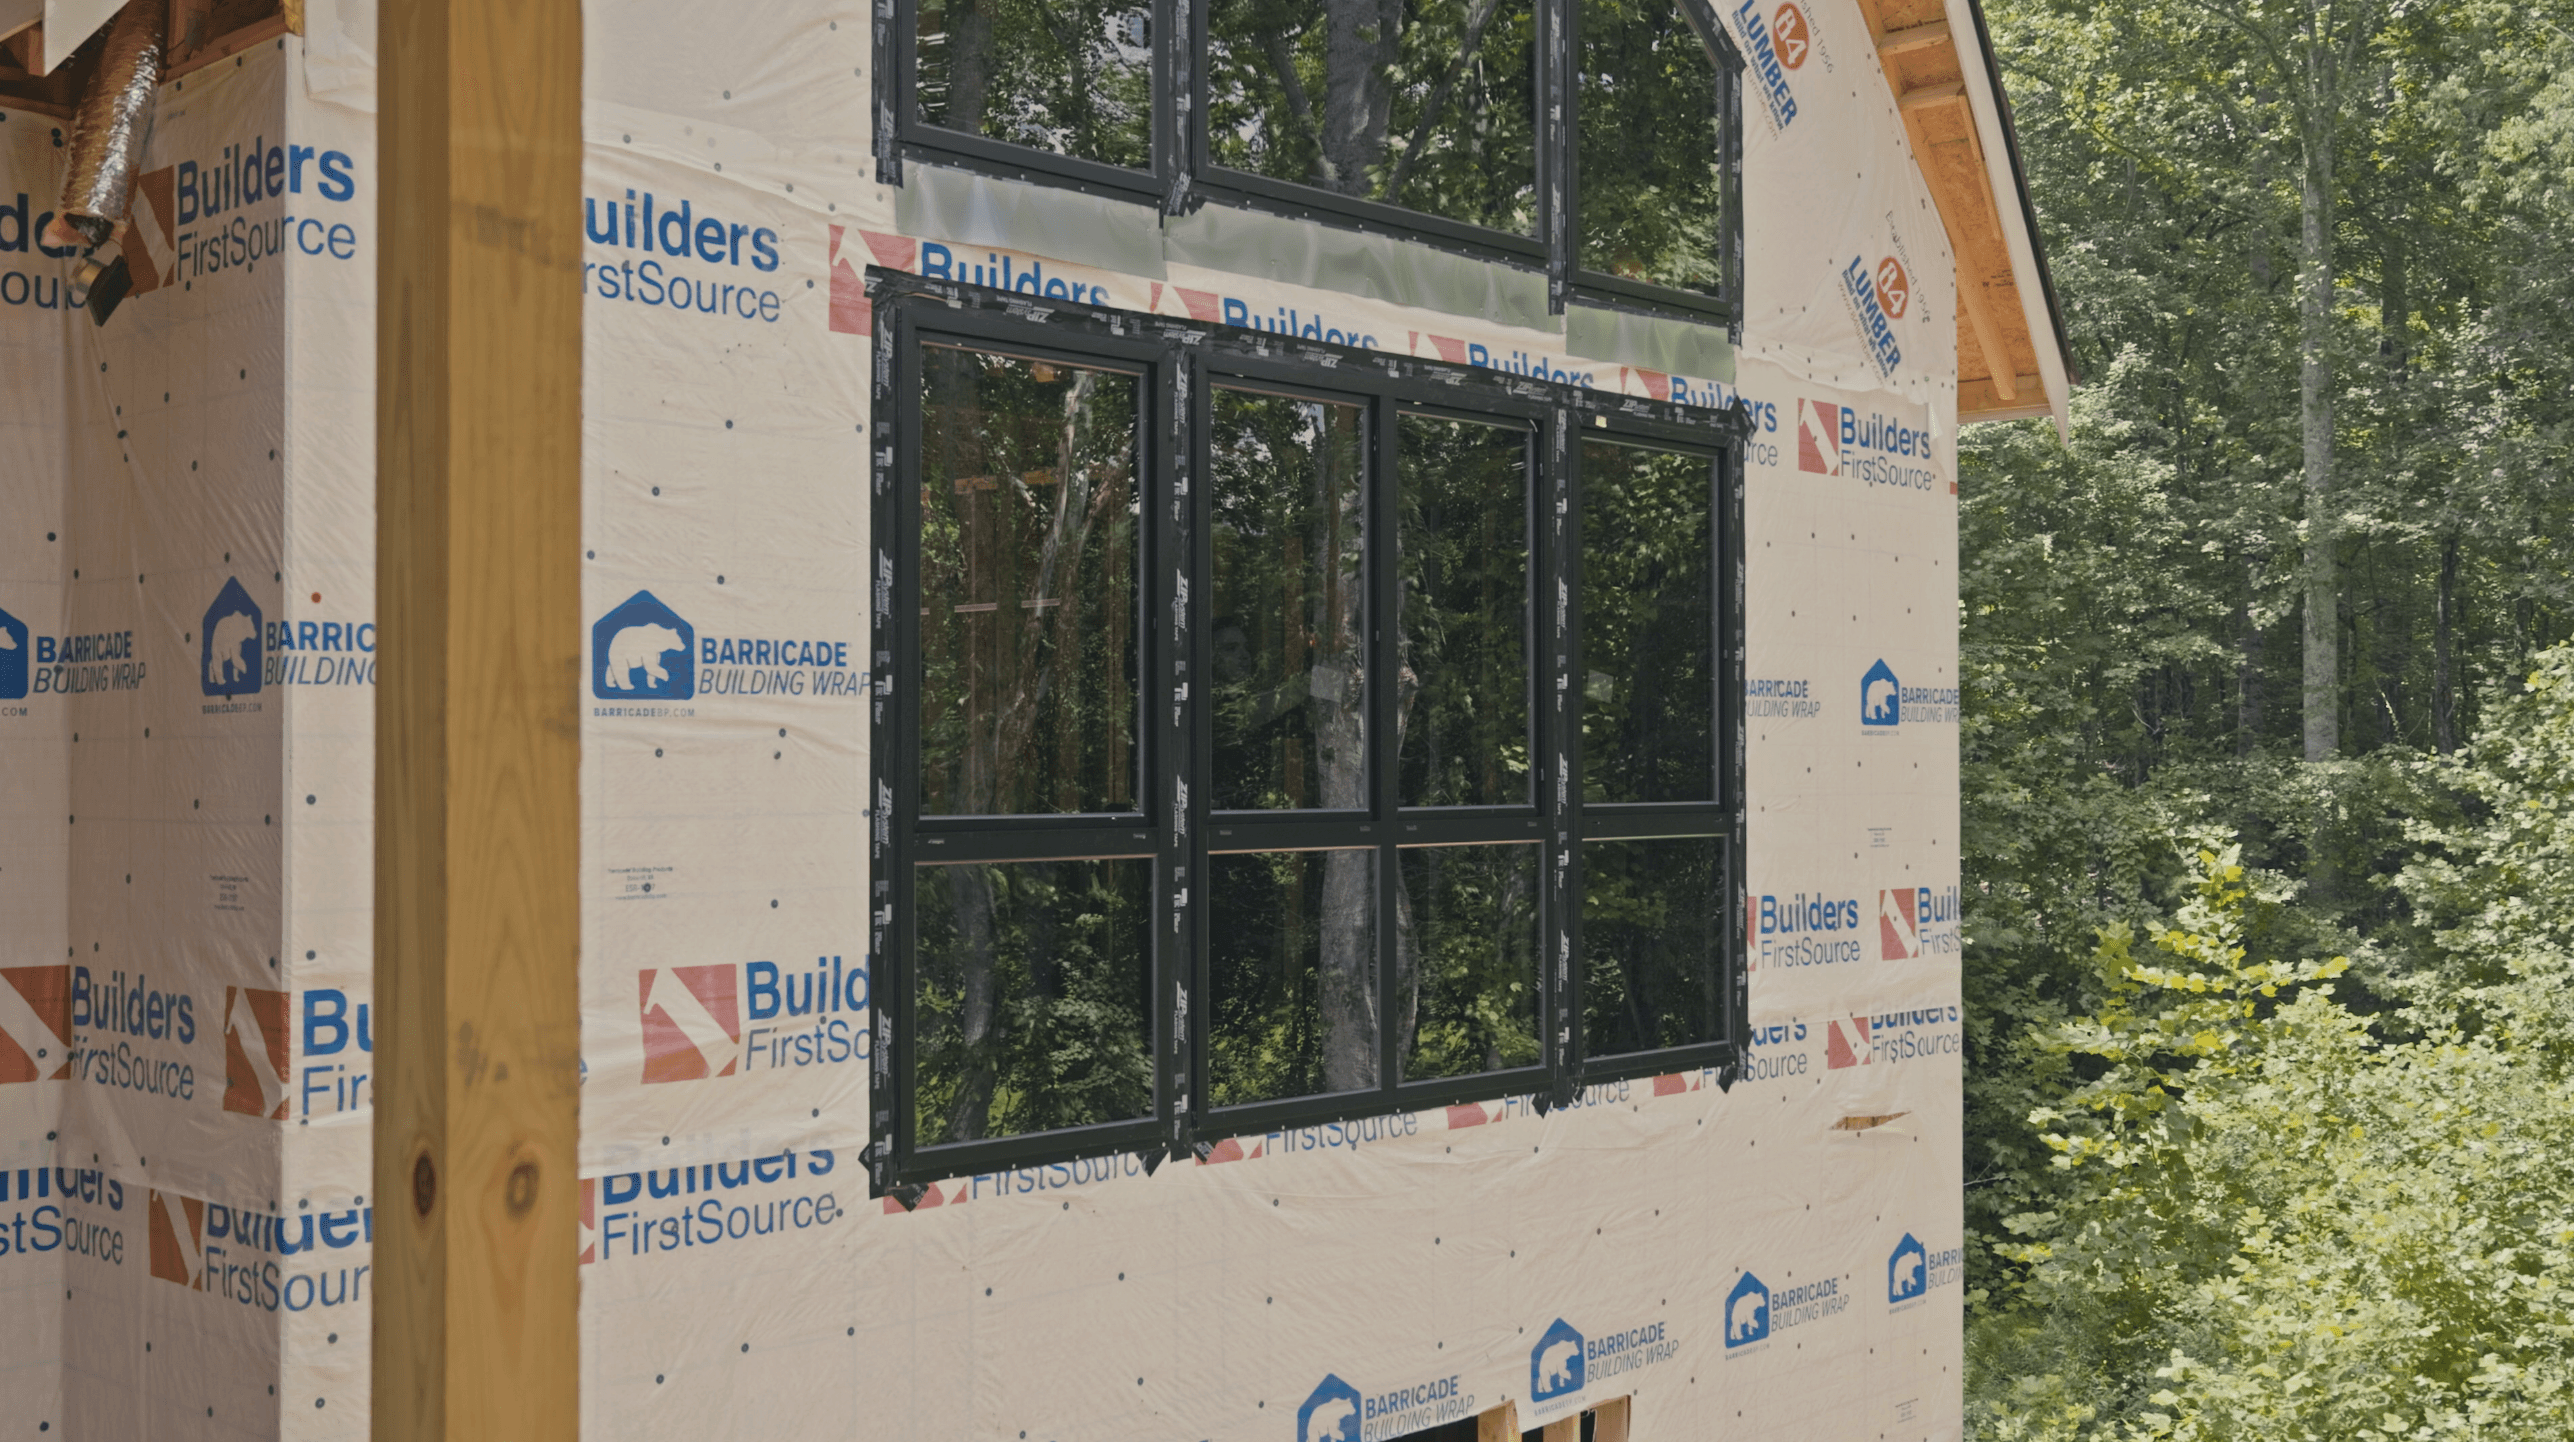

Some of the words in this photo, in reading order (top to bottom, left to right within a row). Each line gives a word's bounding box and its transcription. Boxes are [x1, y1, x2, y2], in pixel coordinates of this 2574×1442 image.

[1731, 10, 1748, 40] Build
[1744, 39, 1754, 56] on
[1750, 55, 1765, 84] what
[1739, 0, 1798, 127] LUMBER
[1815, 39, 1835, 74] 1956
[178, 136, 356, 226] Builders
[177, 213, 357, 282] FirstSource
[1841, 269, 1855, 297] Build
[1853, 295, 1862, 311] on
[1858, 310, 1871, 337] what
[1848, 254, 1902, 374] LUMBER
[1841, 406, 1932, 460] Builders
[1841, 449, 1933, 491] FirstSource
[37, 631, 132, 664] BARRICADE
[701, 637, 848, 667] BARRICADE
[33, 665, 109, 694] BUILDING
[111, 661, 147, 692] WRAP
[698, 668, 804, 696] BUILDING
[812, 671, 870, 696] WRAP
[1901, 687, 1959, 705] BARRICADE
[593, 707, 695, 718] BARRICADEBP.COM
[1790, 700, 1821, 718] WRAP
[1900, 706, 1942, 722] BUILDING
[1760, 892, 1859, 934] Builders
[1761, 937, 1861, 969] FirstSource
[72, 966, 196, 1045] Builders
[1872, 1031, 1960, 1064] FirstSource
[603, 1193, 837, 1260] FirstSource
[1771, 1302, 1819, 1333] BUILDING
[1821, 1294, 1851, 1318] WRAP
[1772, 1278, 1838, 1312] BARRICADE
[1587, 1321, 1666, 1361] BARRICADE
[1587, 1350, 1642, 1385] BUILDING
[1645, 1340, 1679, 1372] WRAP
[1364, 1402, 1433, 1442] BUILDING
[1434, 1394, 1475, 1429] WRAP
[1366, 1375, 1459, 1421] BARRICADE
